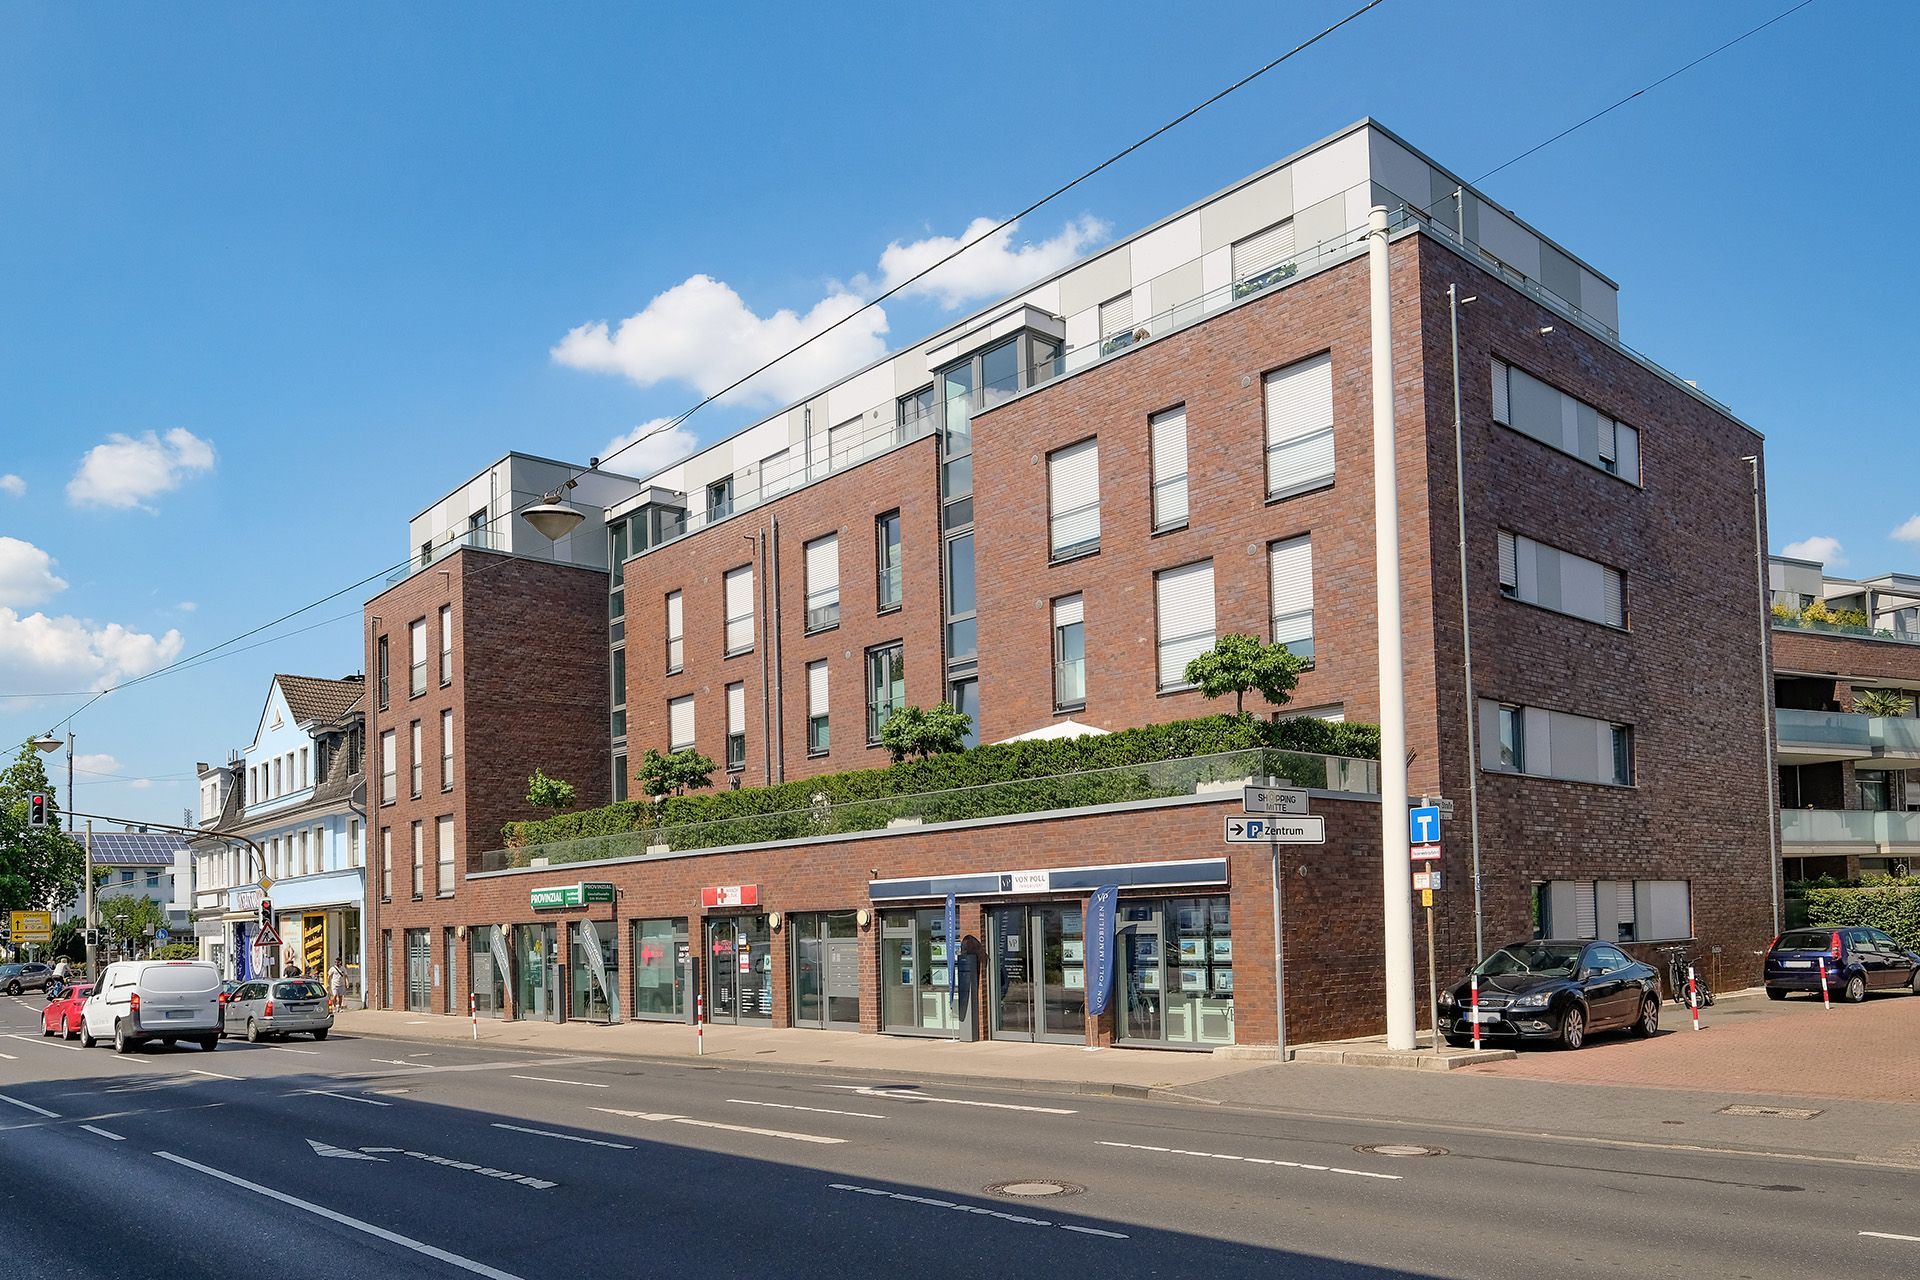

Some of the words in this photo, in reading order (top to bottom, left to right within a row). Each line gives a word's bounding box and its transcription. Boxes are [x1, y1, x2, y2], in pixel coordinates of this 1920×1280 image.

[1258, 791, 1297, 804] SHOPPING
[1266, 803, 1287, 812] MITTE
[1265, 827, 1304, 836] Zentrum
[531, 892, 563, 904] PROVINZIAL
[1097, 893, 1109, 903] VP
